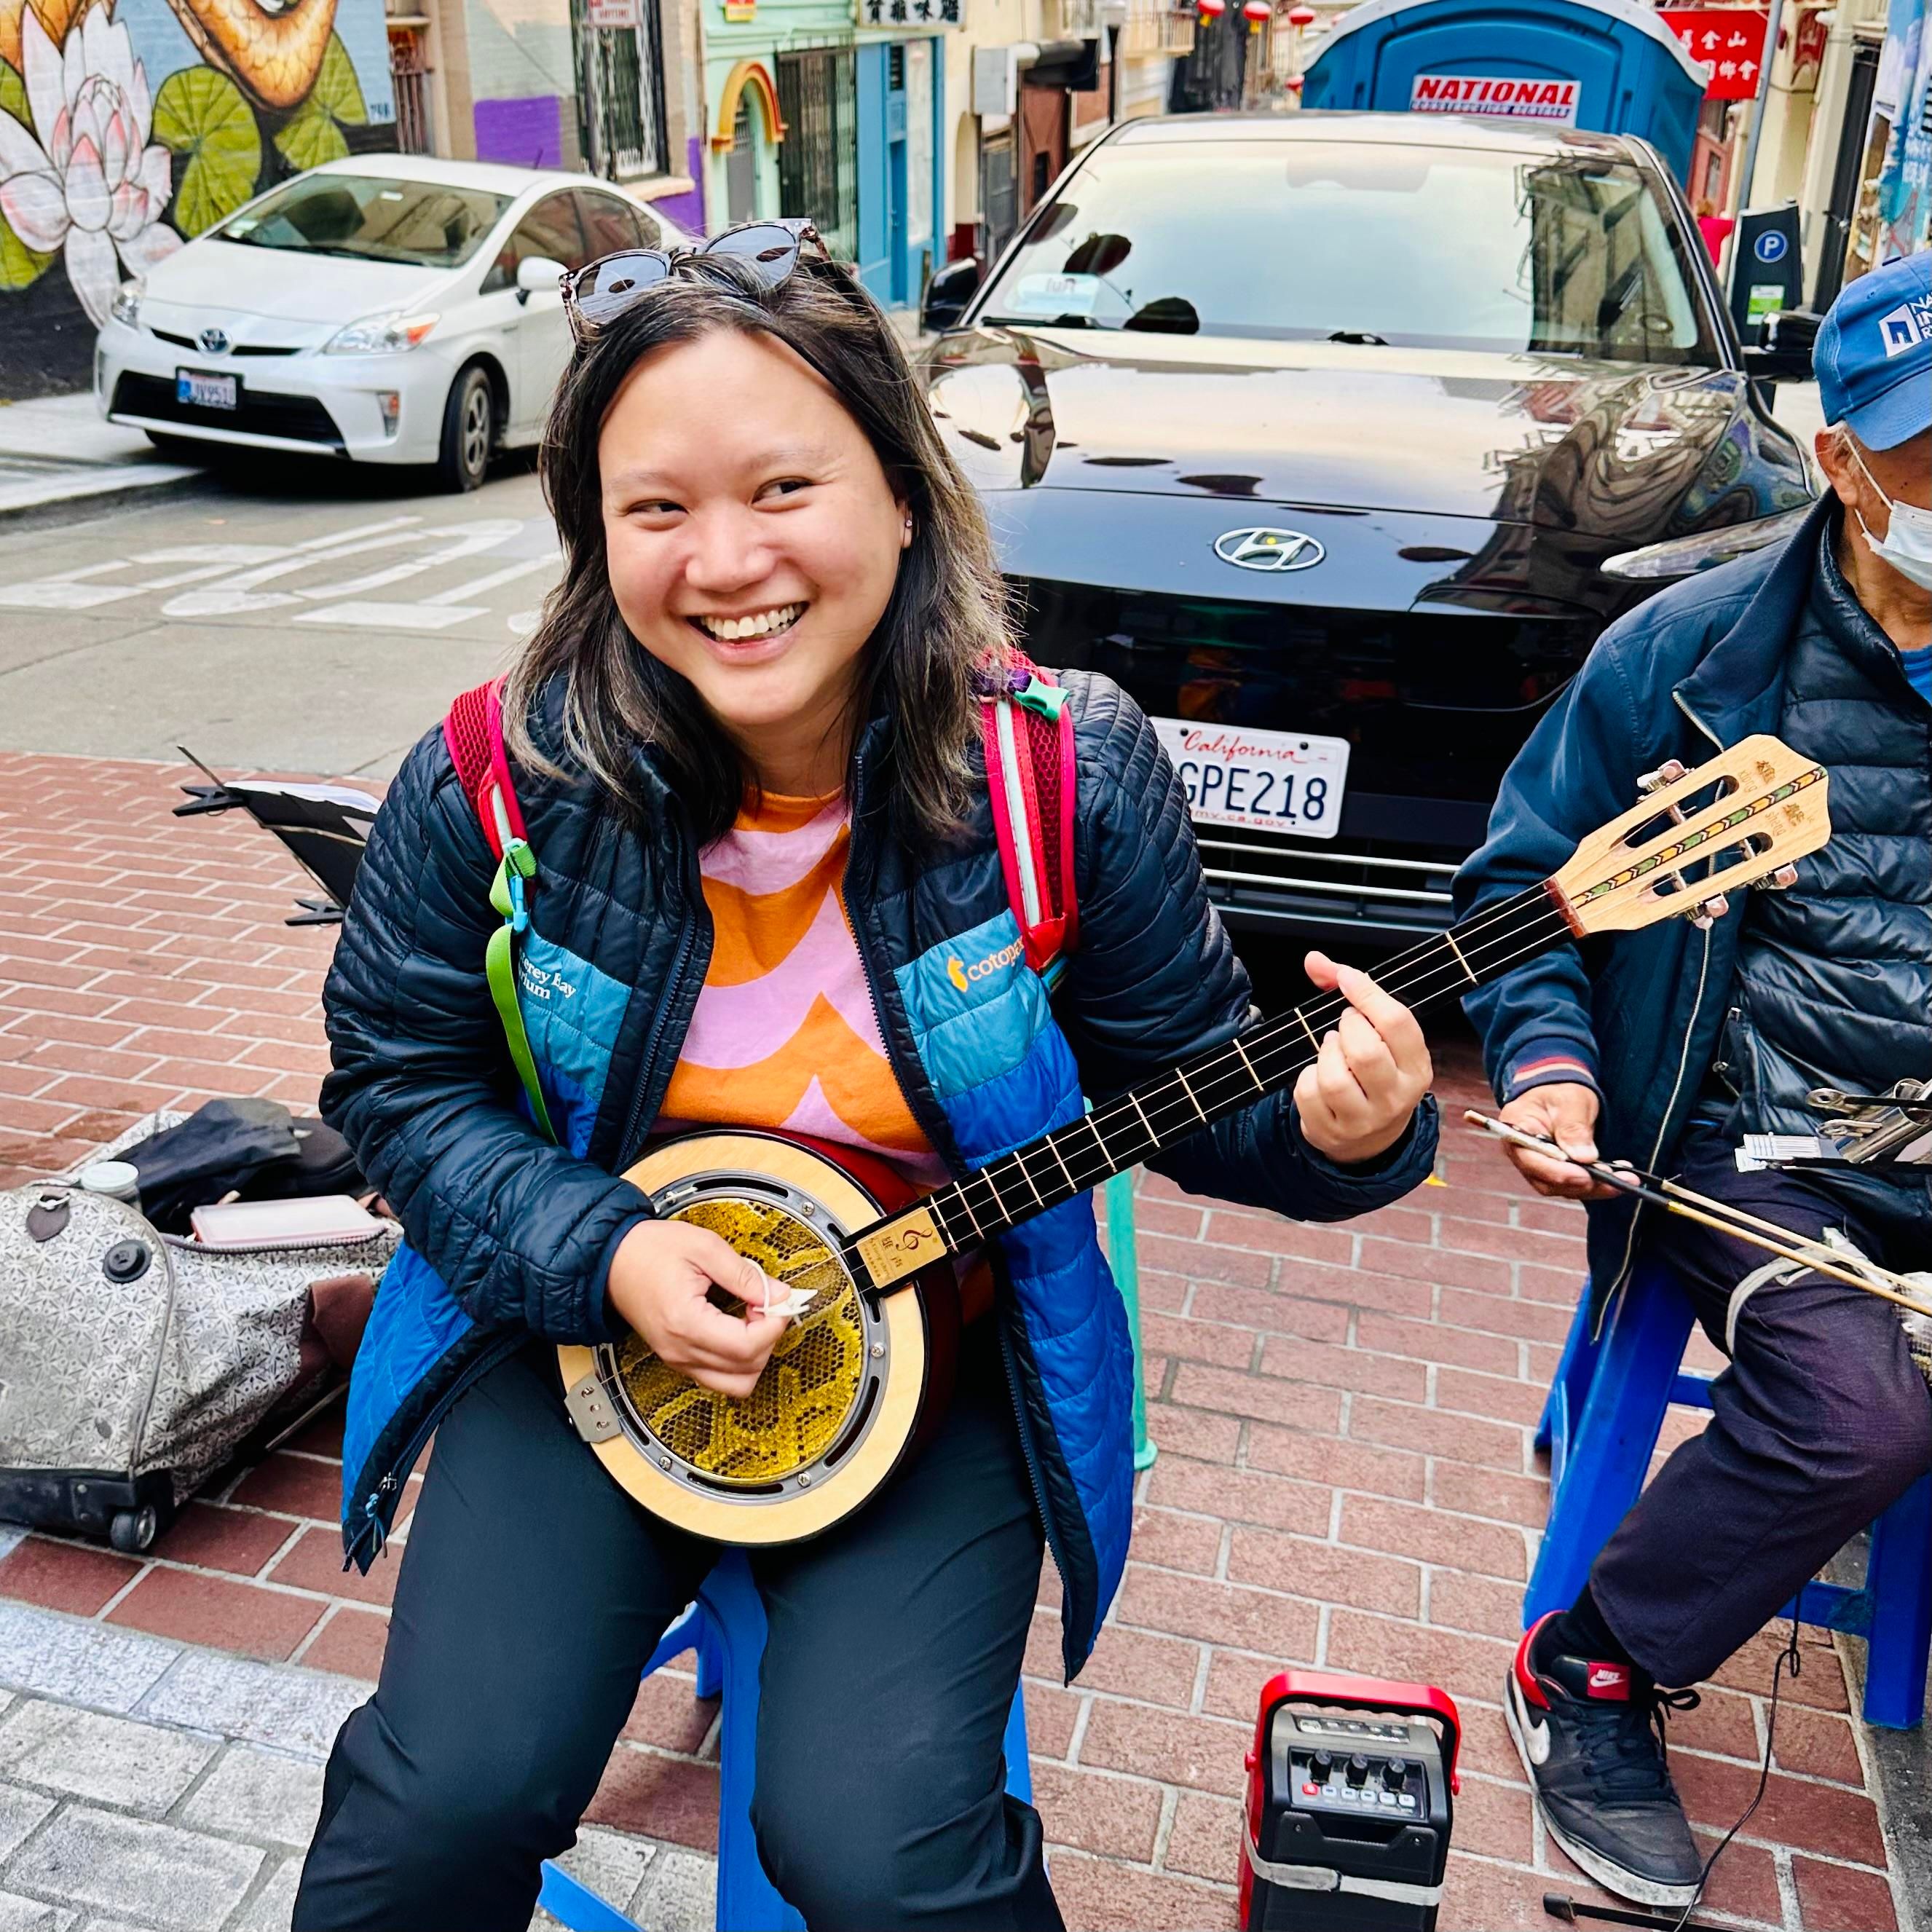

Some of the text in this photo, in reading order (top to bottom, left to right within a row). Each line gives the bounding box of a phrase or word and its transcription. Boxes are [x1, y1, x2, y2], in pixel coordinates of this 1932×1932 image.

[1416, 78, 1574, 105] NATIONAL
[1763, 236, 1780, 256] P
[1184, 730, 1309, 764] California
[1179, 762, 1328, 821] GPE218
